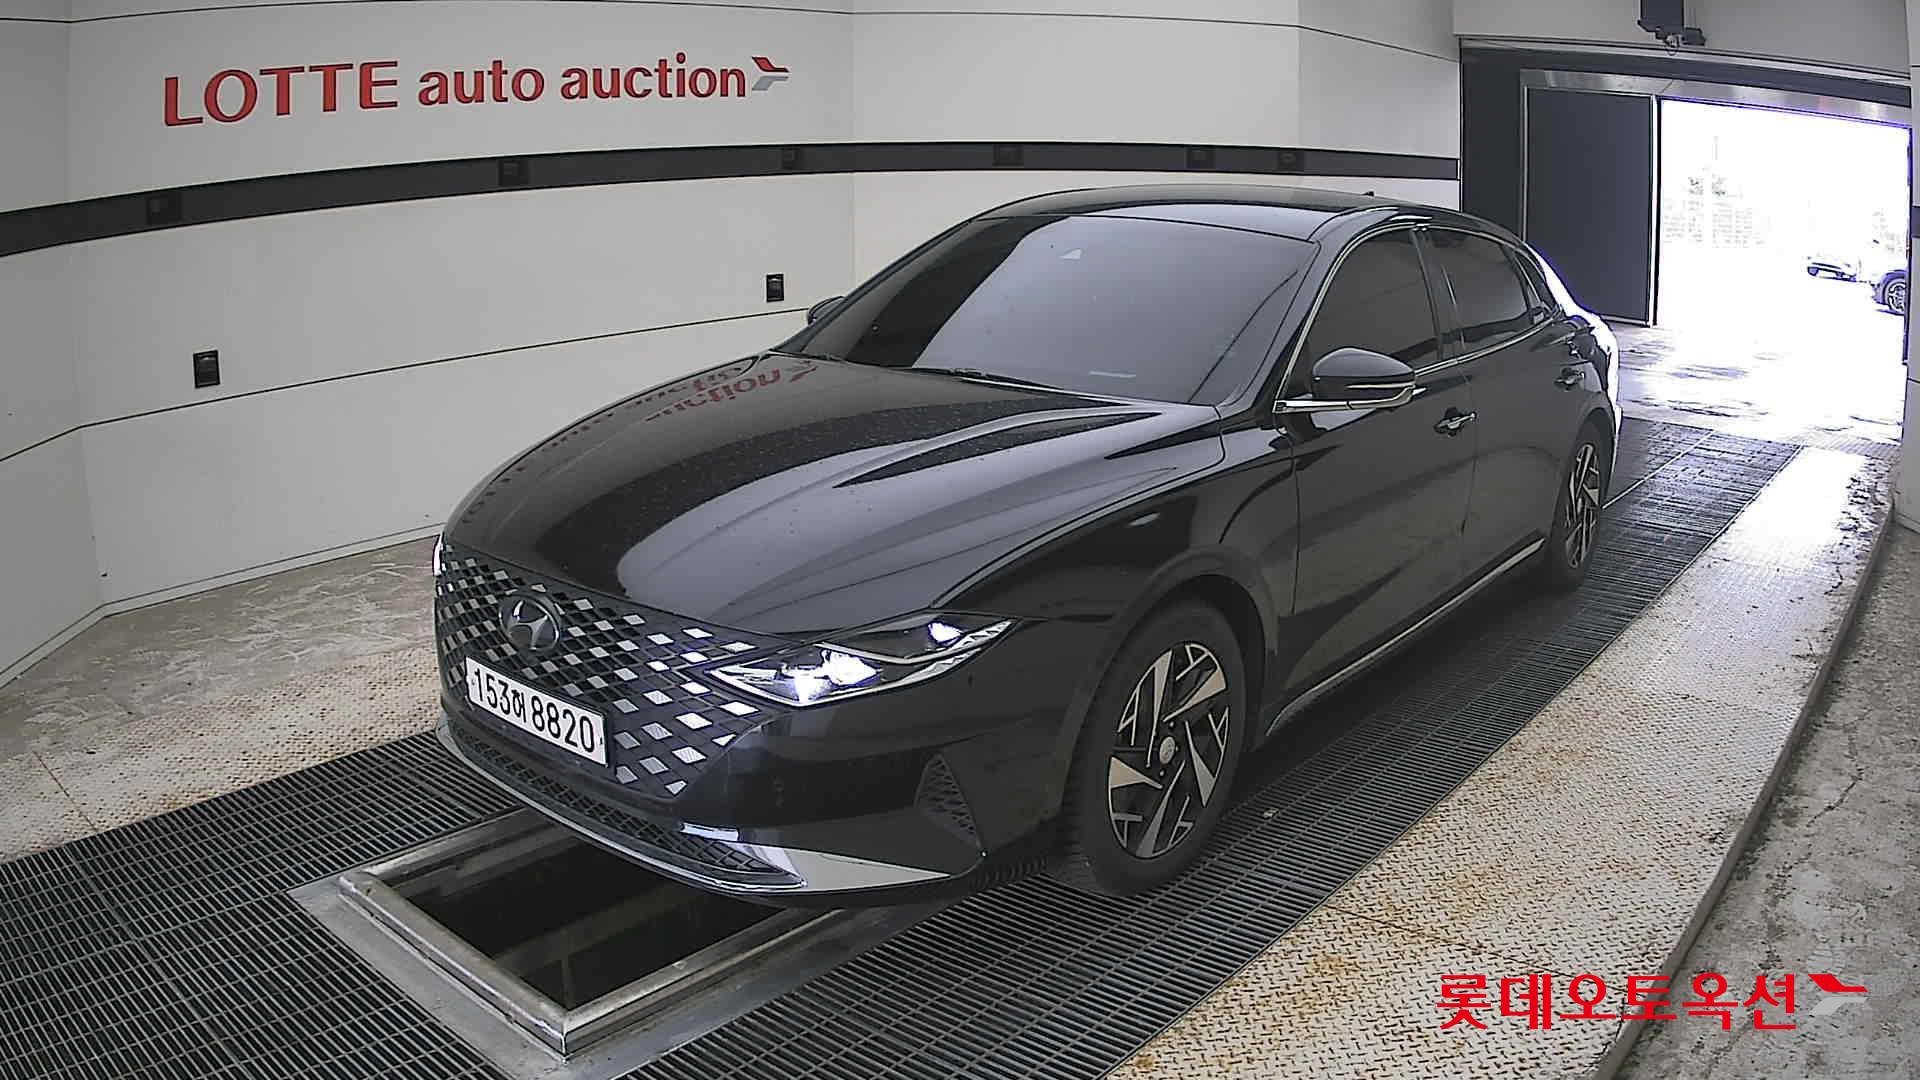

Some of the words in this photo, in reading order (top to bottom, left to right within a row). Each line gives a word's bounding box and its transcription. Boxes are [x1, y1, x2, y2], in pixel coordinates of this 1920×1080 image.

[164, 60, 398, 126] LOTTE
[417, 60, 544, 106] auto
[560, 53, 746, 99] auction
[530, 695, 595, 753] 8820
